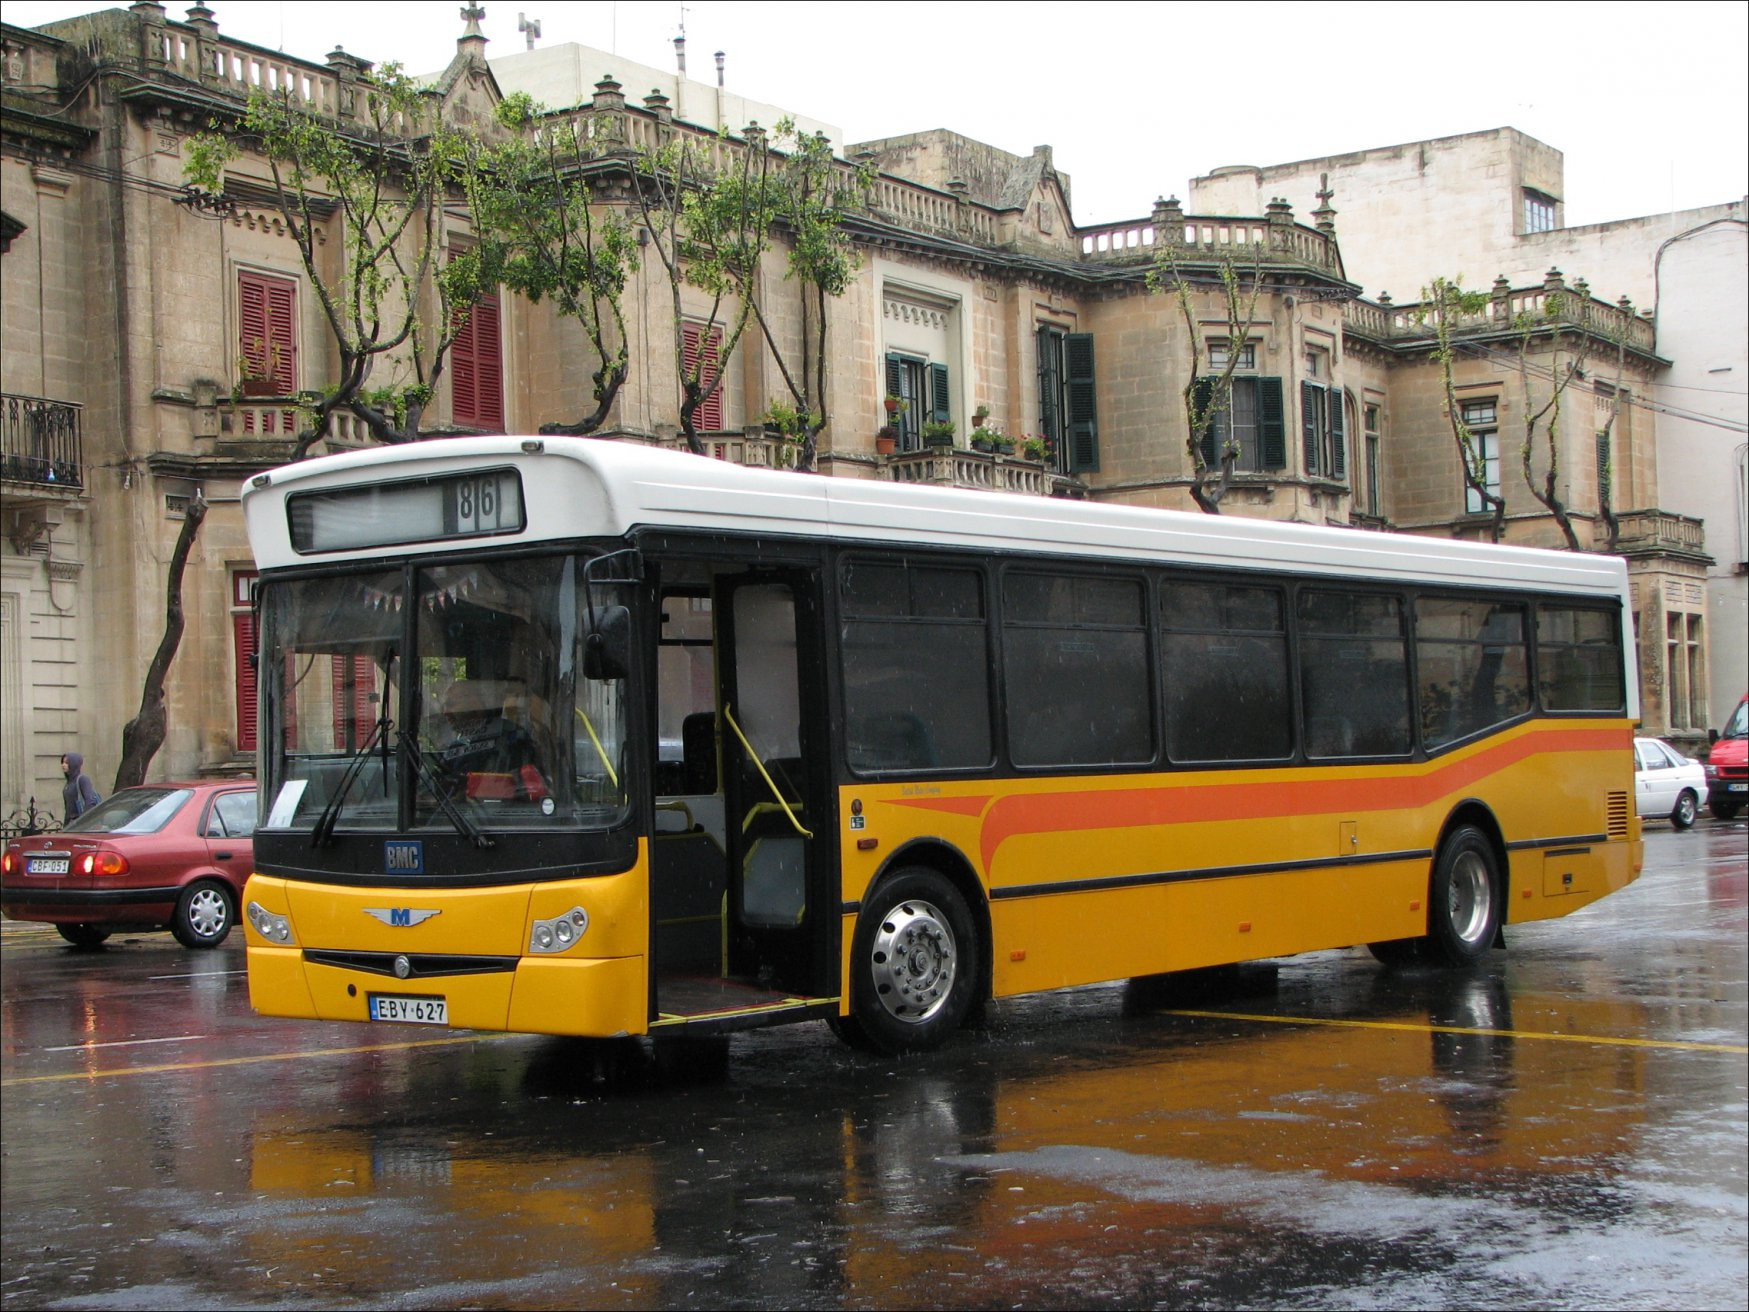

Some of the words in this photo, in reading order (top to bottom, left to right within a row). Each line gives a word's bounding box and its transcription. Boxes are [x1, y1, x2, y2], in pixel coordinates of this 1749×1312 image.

[460, 480, 494, 519] 86
[387, 846, 419, 869] BMC
[391, 908, 411, 925] M
